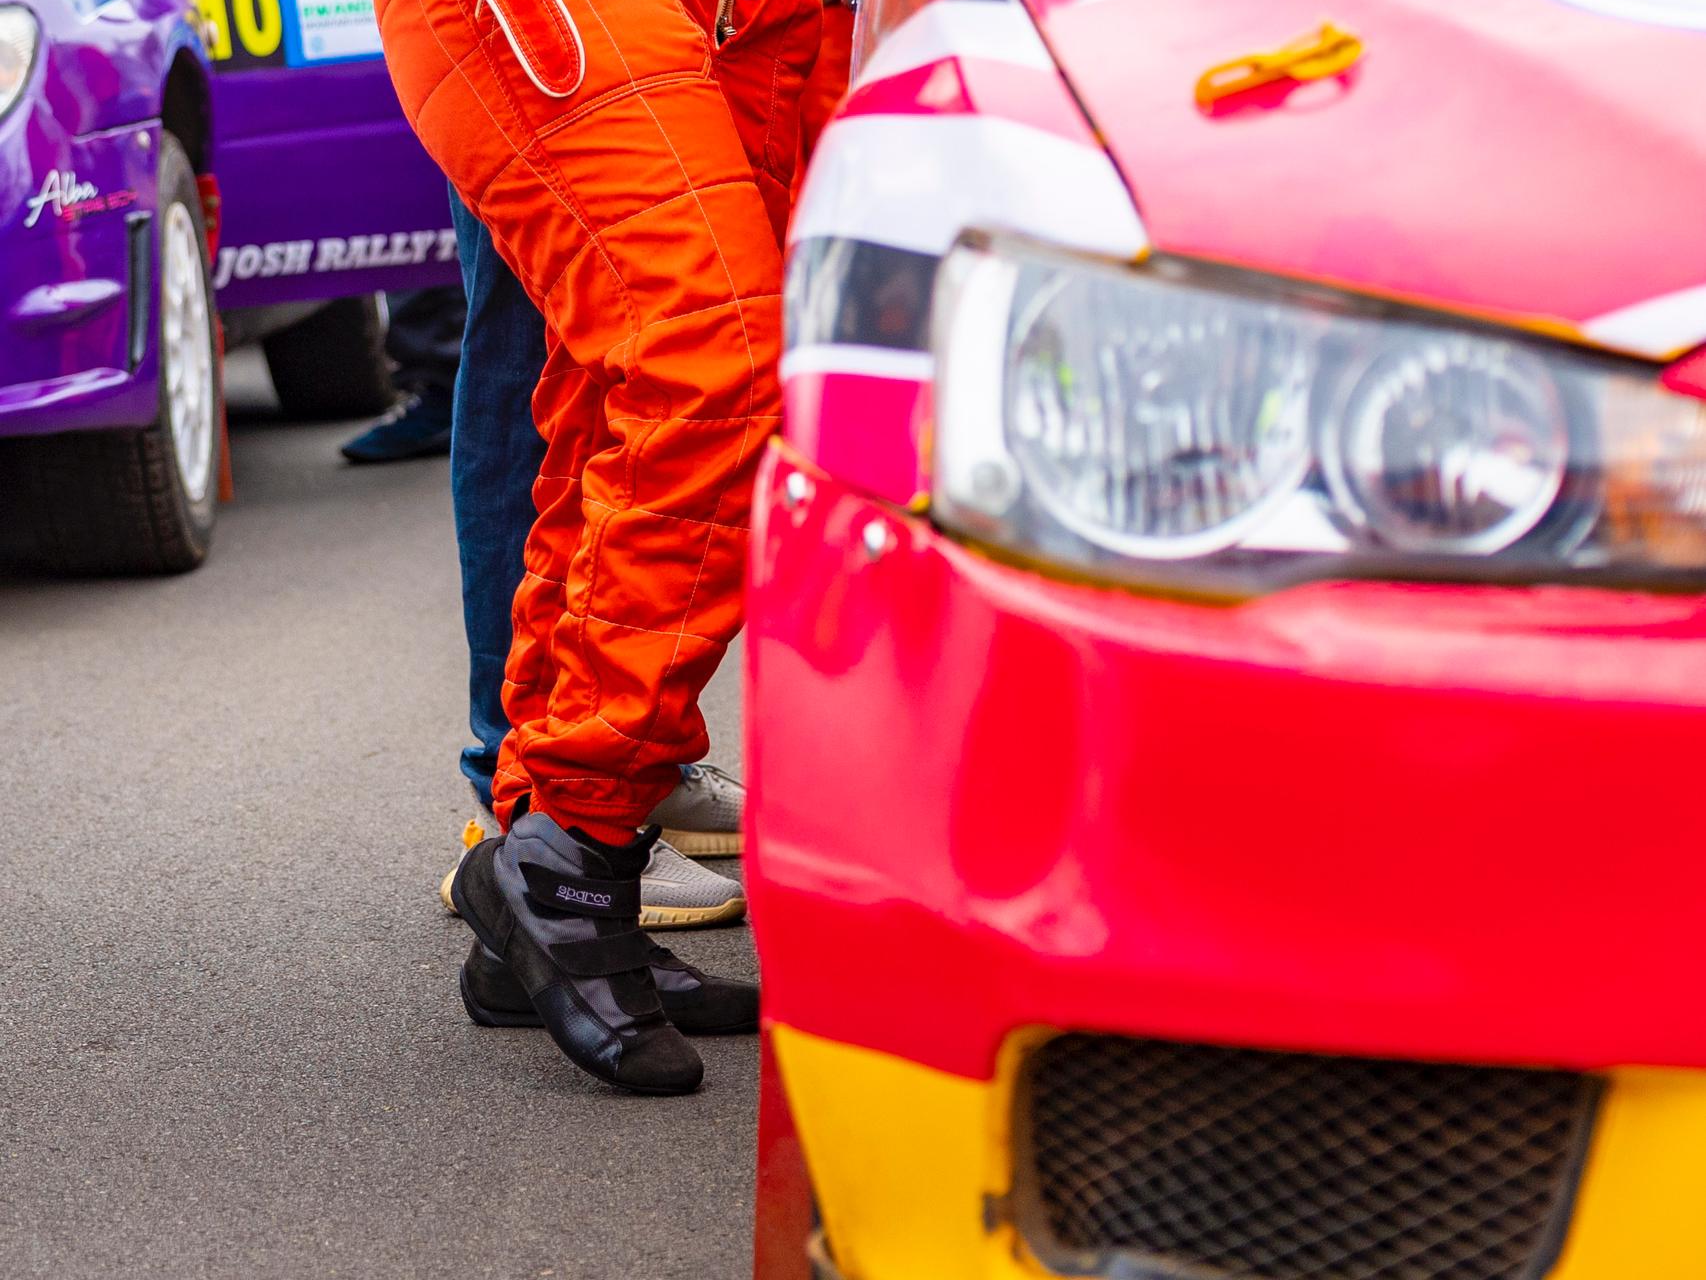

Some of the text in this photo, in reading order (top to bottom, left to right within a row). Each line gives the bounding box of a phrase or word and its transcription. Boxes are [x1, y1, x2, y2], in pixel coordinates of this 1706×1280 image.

[213, 227, 459, 291] JOSH RALLY T
[557, 885, 611, 905] sparco
